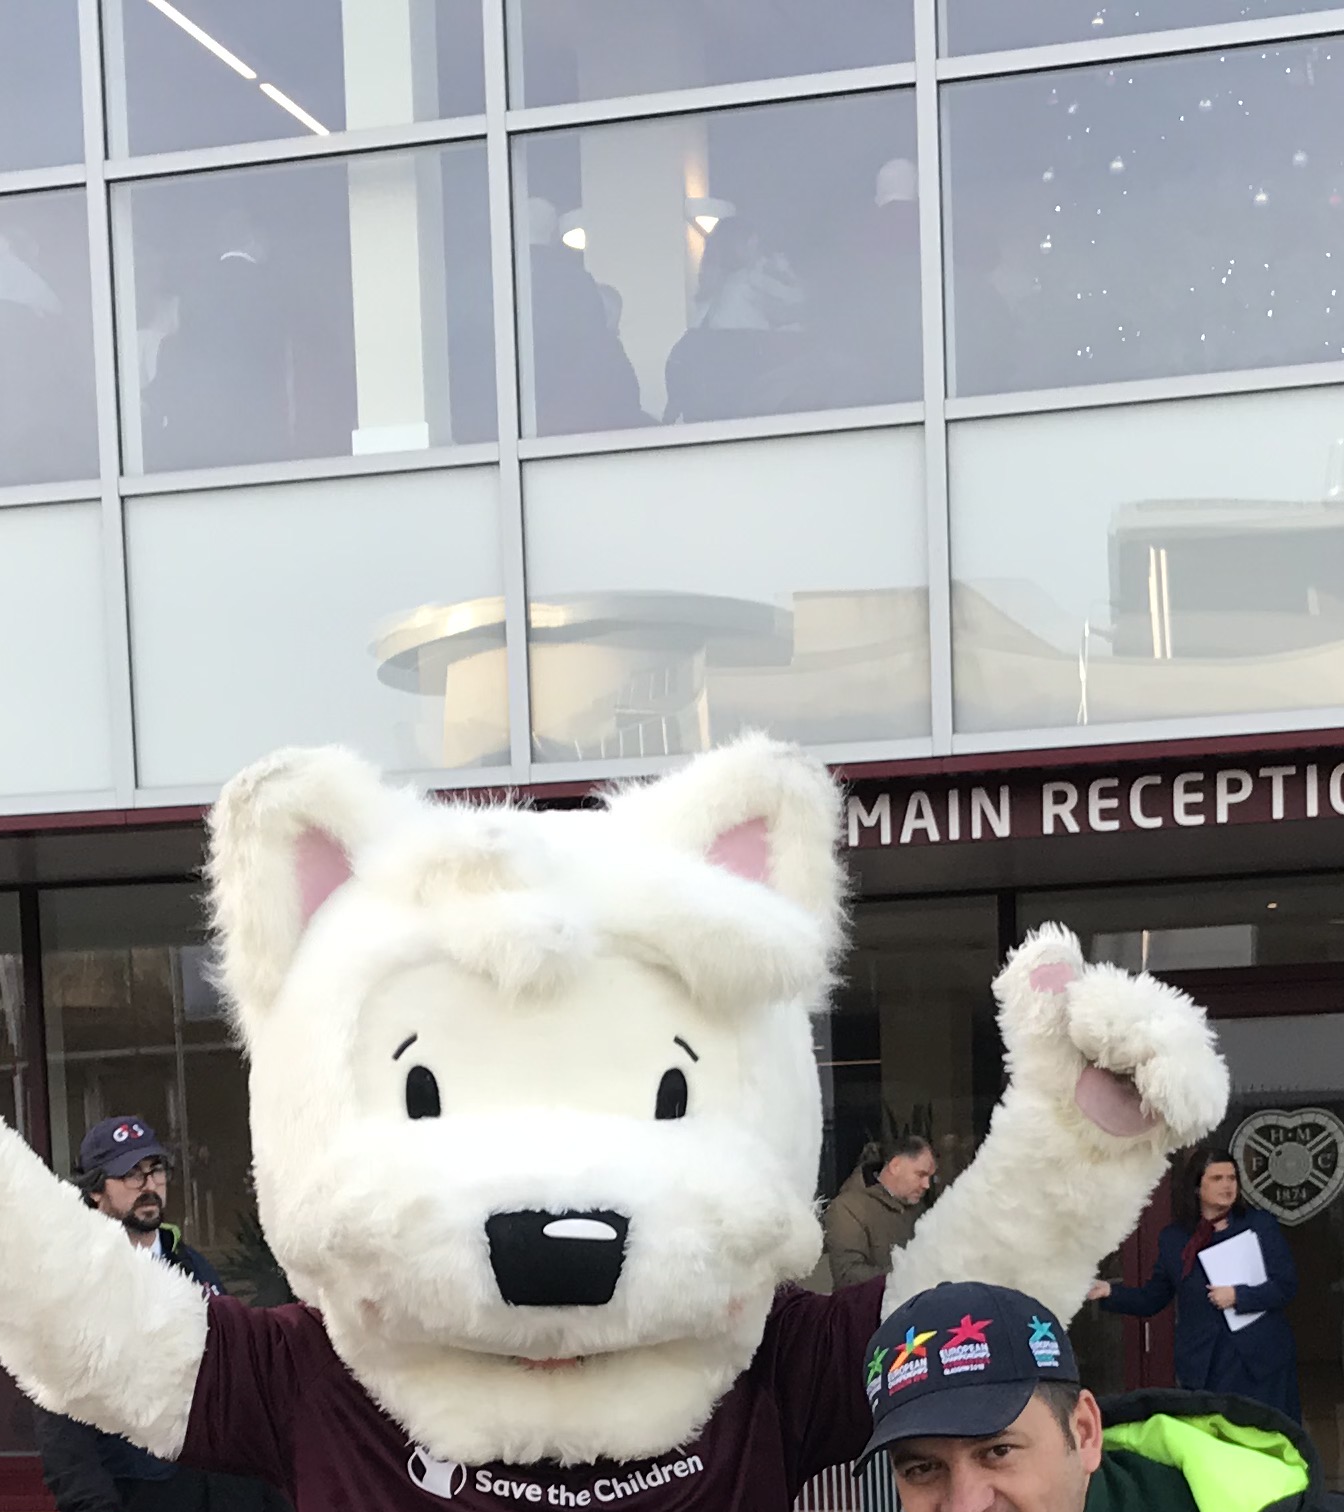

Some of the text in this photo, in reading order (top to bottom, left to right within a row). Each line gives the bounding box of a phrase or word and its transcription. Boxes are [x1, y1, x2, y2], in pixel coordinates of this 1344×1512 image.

[848, 784, 1011, 847] MAIN
[475, 1454, 704, 1507] Save the Children
